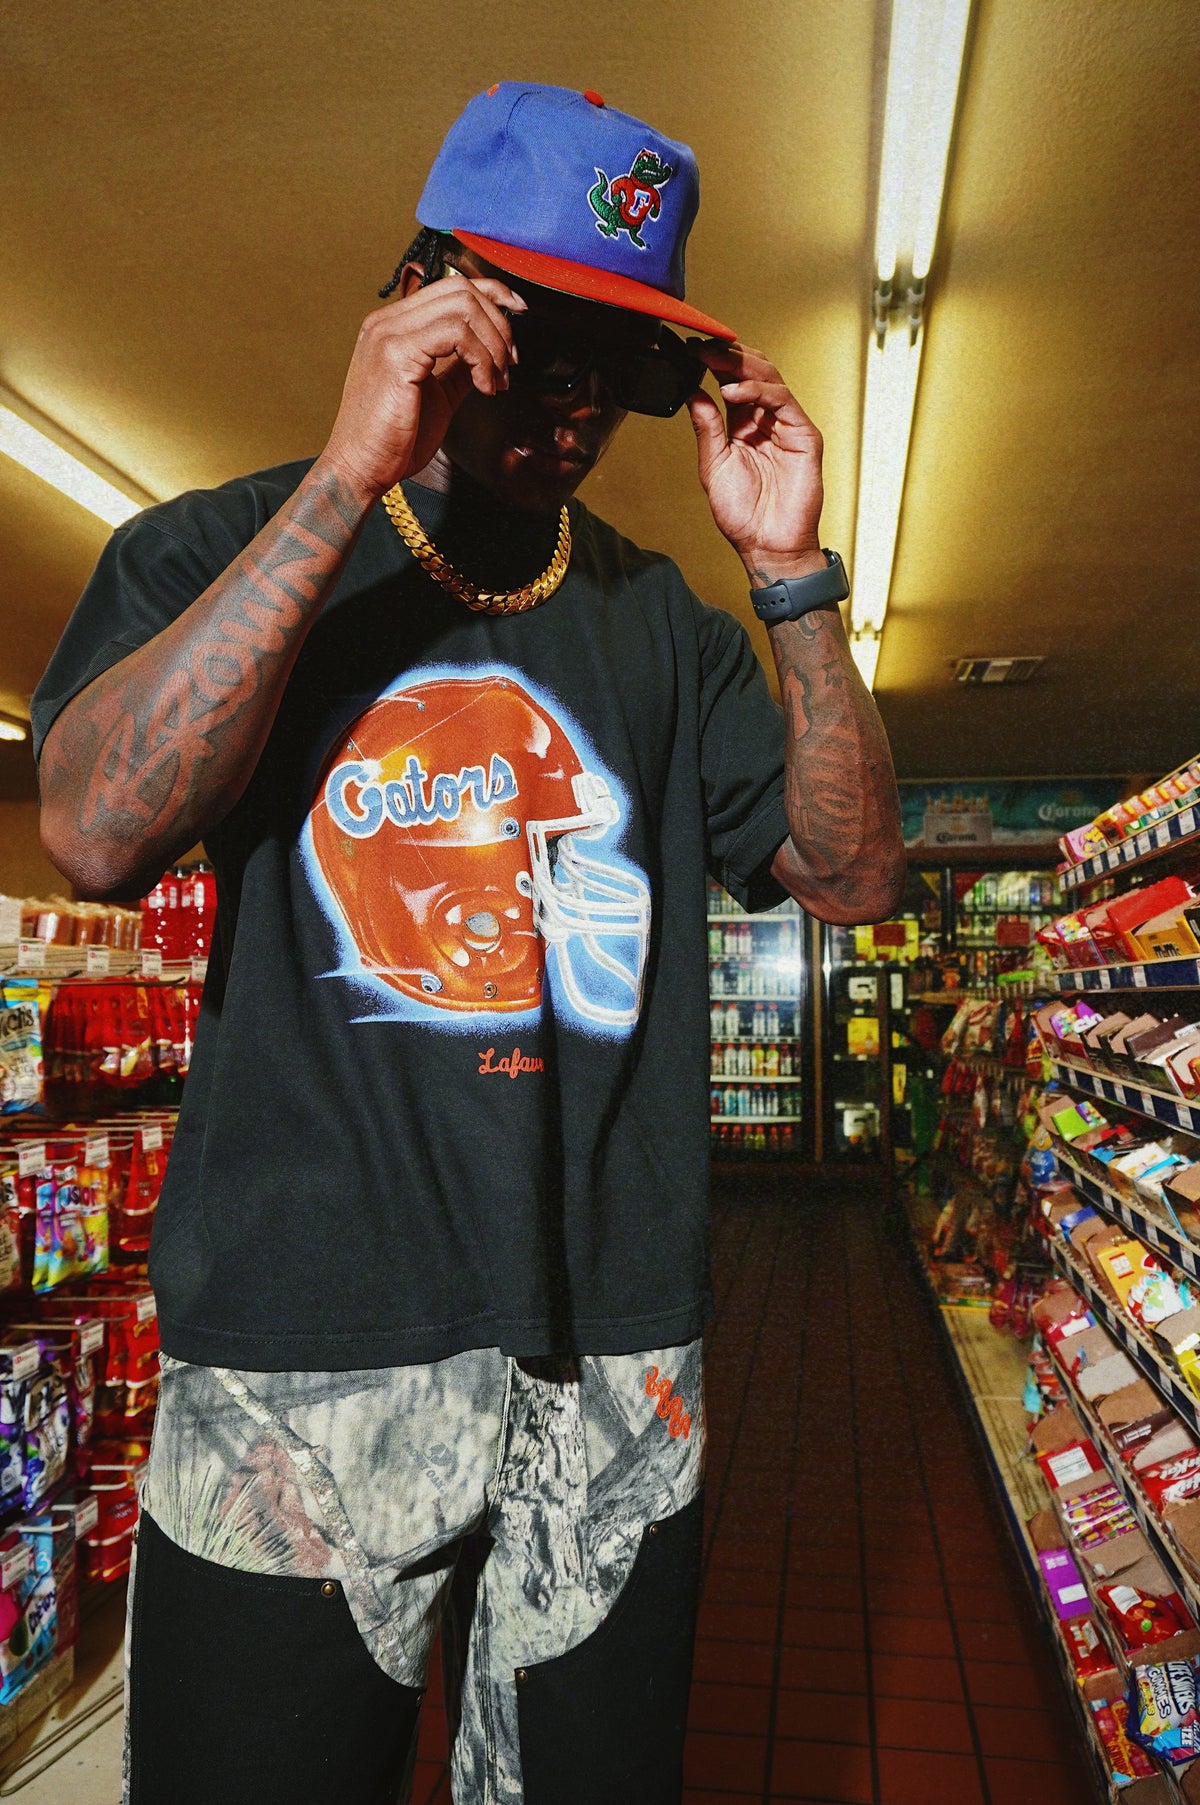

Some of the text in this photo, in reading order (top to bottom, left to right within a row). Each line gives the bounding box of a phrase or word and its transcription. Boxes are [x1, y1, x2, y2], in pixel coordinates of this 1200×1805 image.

[628, 188, 652, 217] F
[326, 752, 519, 839] Gators
[1148, 1668, 1172, 1719] GUMMIES
